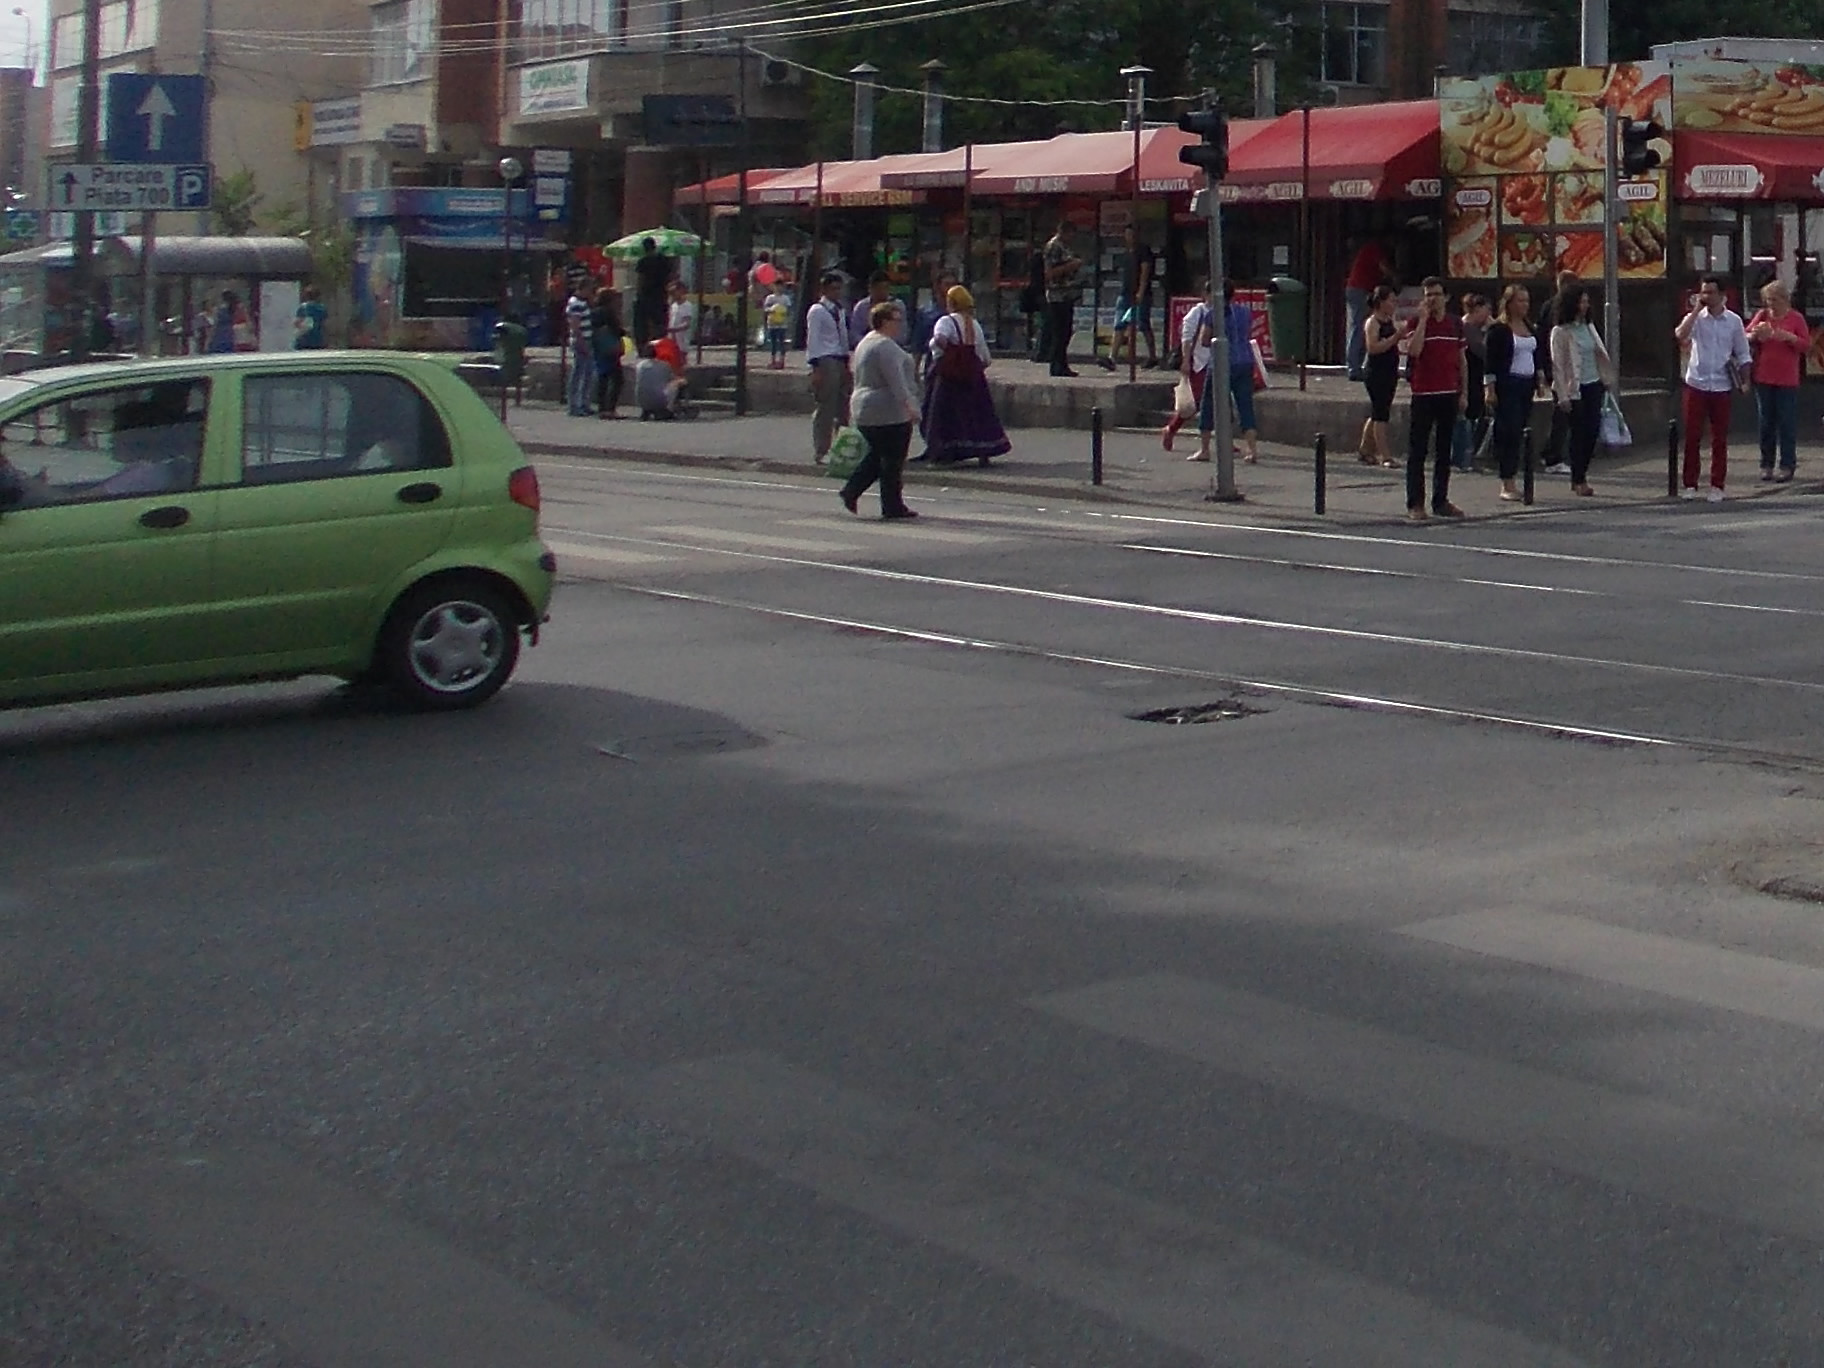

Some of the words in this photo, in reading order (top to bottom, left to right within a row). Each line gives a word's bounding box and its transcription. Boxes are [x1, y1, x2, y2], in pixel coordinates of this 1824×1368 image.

[91, 167, 164, 184] Parcare
[139, 187, 170, 205] 700
[1417, 180, 1439, 195] AG
